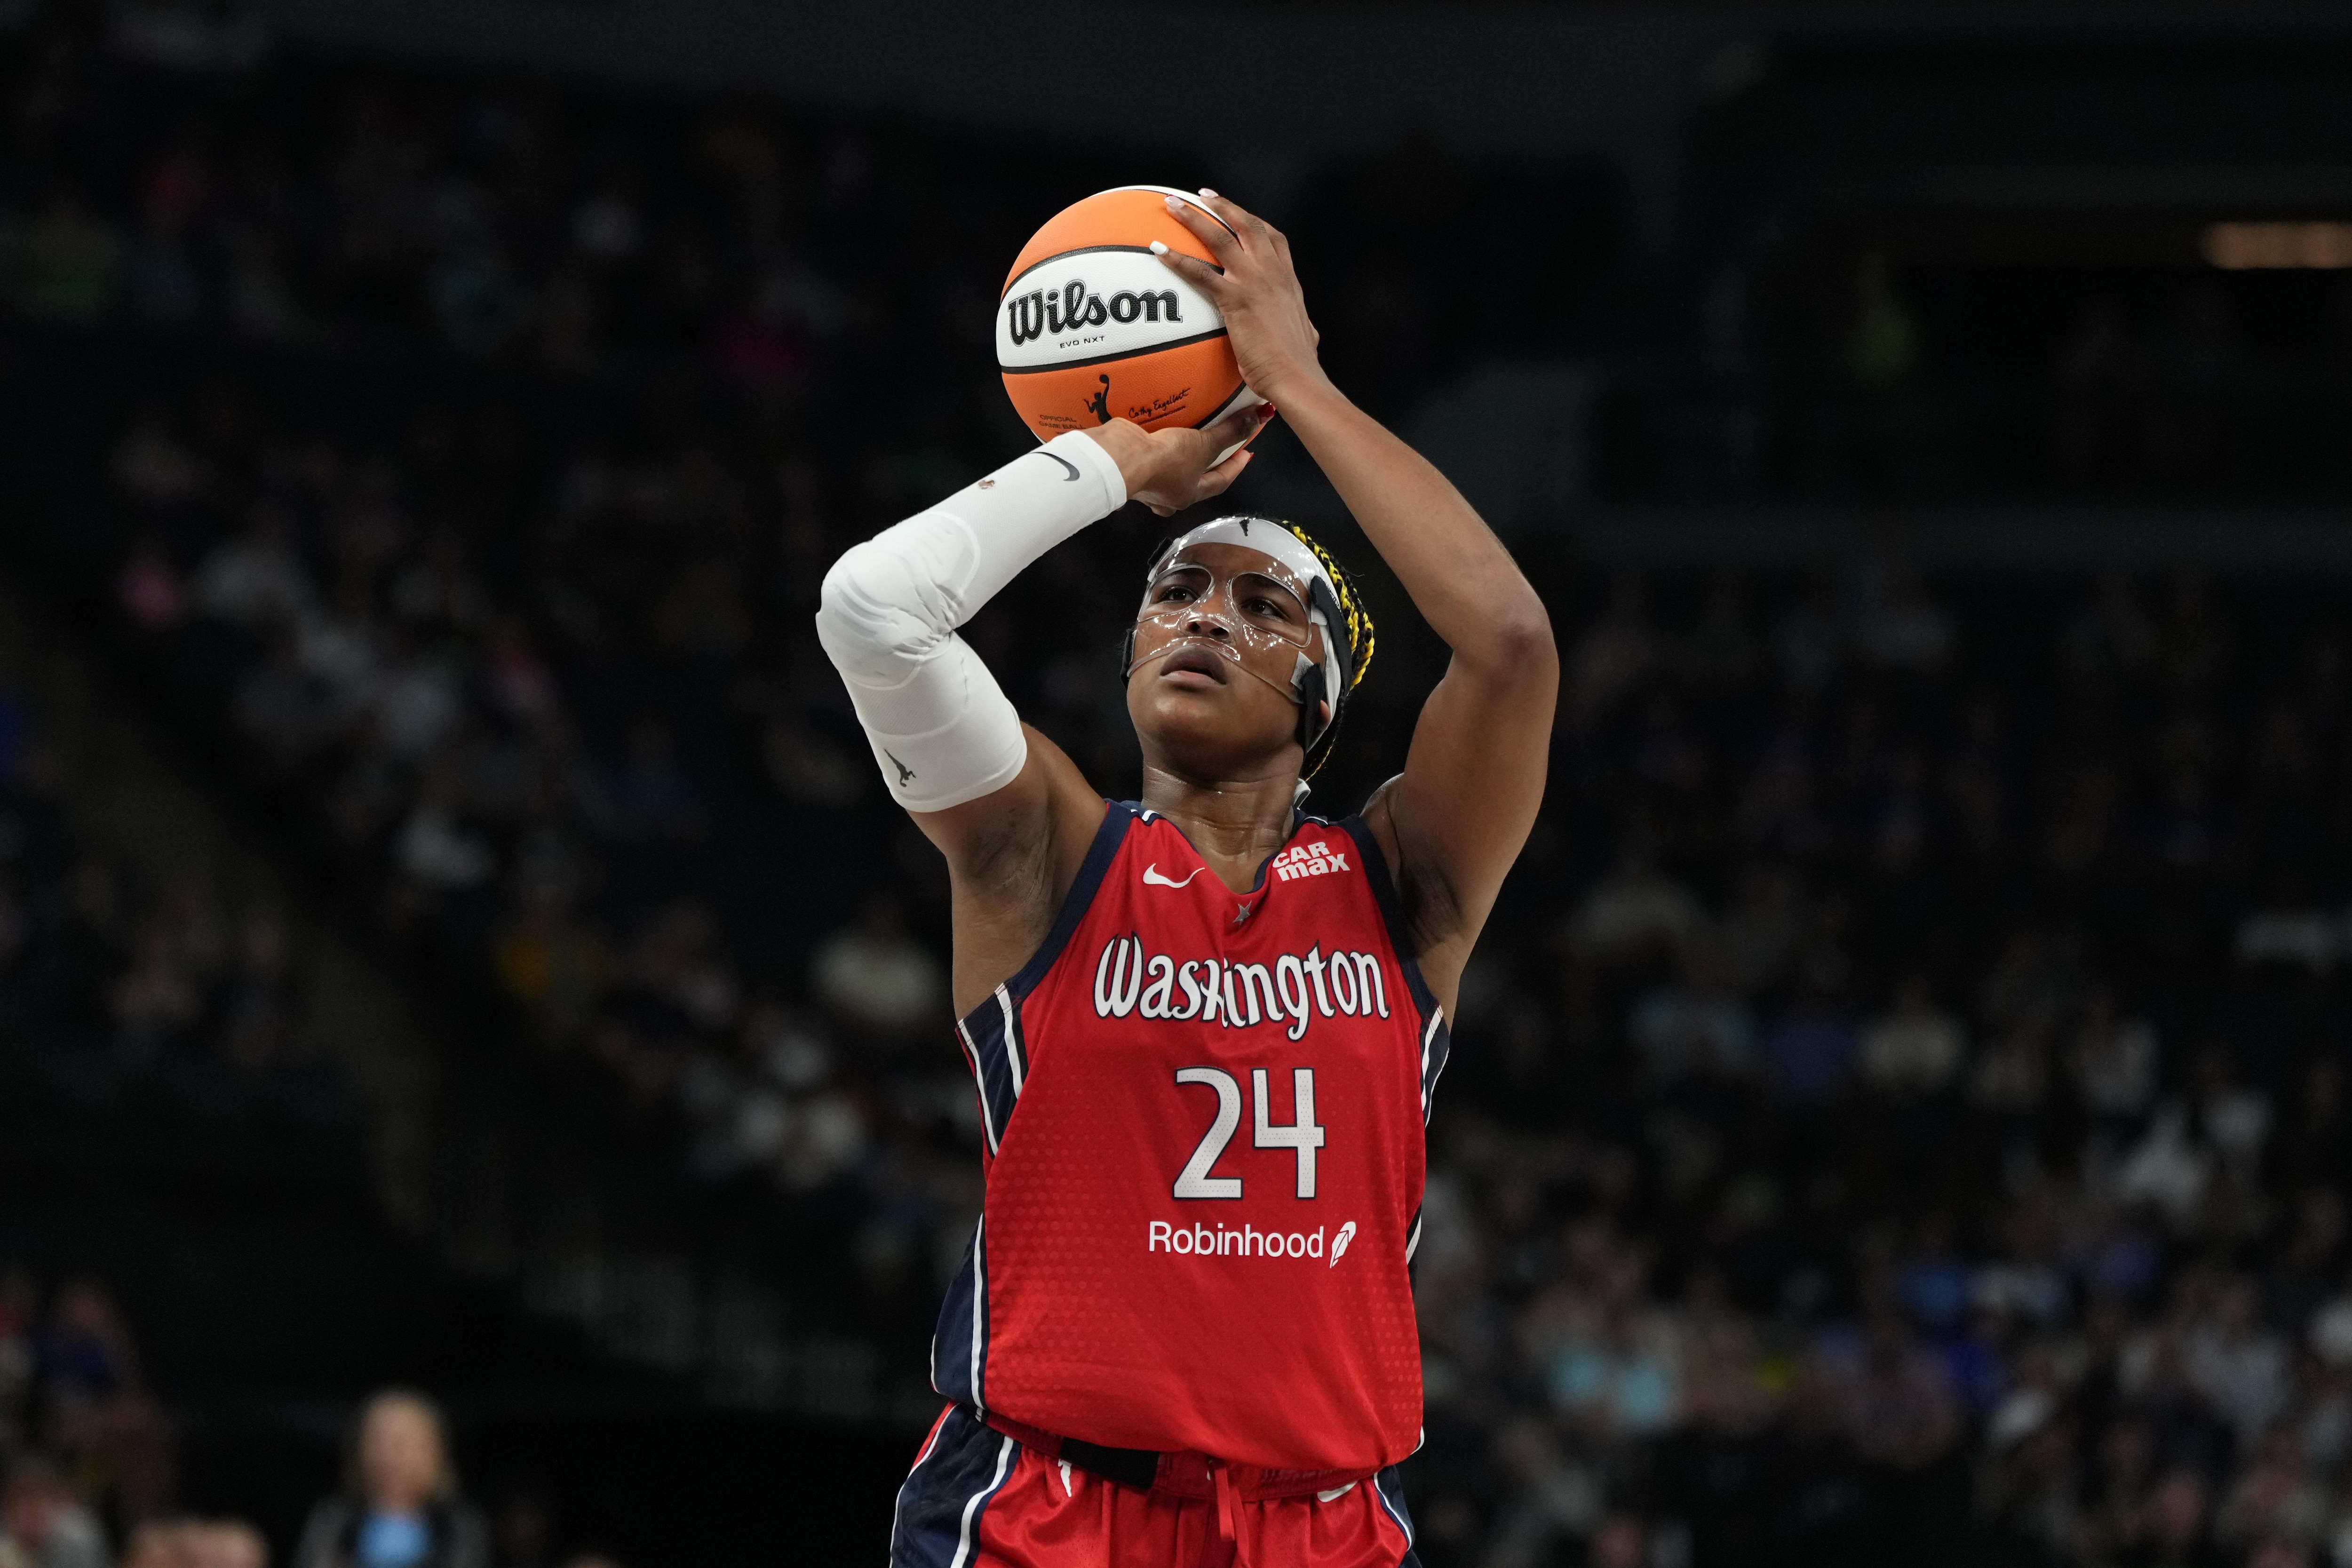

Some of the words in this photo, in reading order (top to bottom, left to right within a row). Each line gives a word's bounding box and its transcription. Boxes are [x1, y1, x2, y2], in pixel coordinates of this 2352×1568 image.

[1008, 279, 1183, 347] Wilson
[1060, 340, 1079, 349] EVO
[1039, 421, 1062, 429] GAME
[1272, 841, 1330, 868] CAR
[1277, 853, 1351, 882] max
[1093, 931, 1390, 1042] Washington
[1172, 1065, 1326, 1201] 24
[1149, 1221, 1324, 1258] Robinhood
